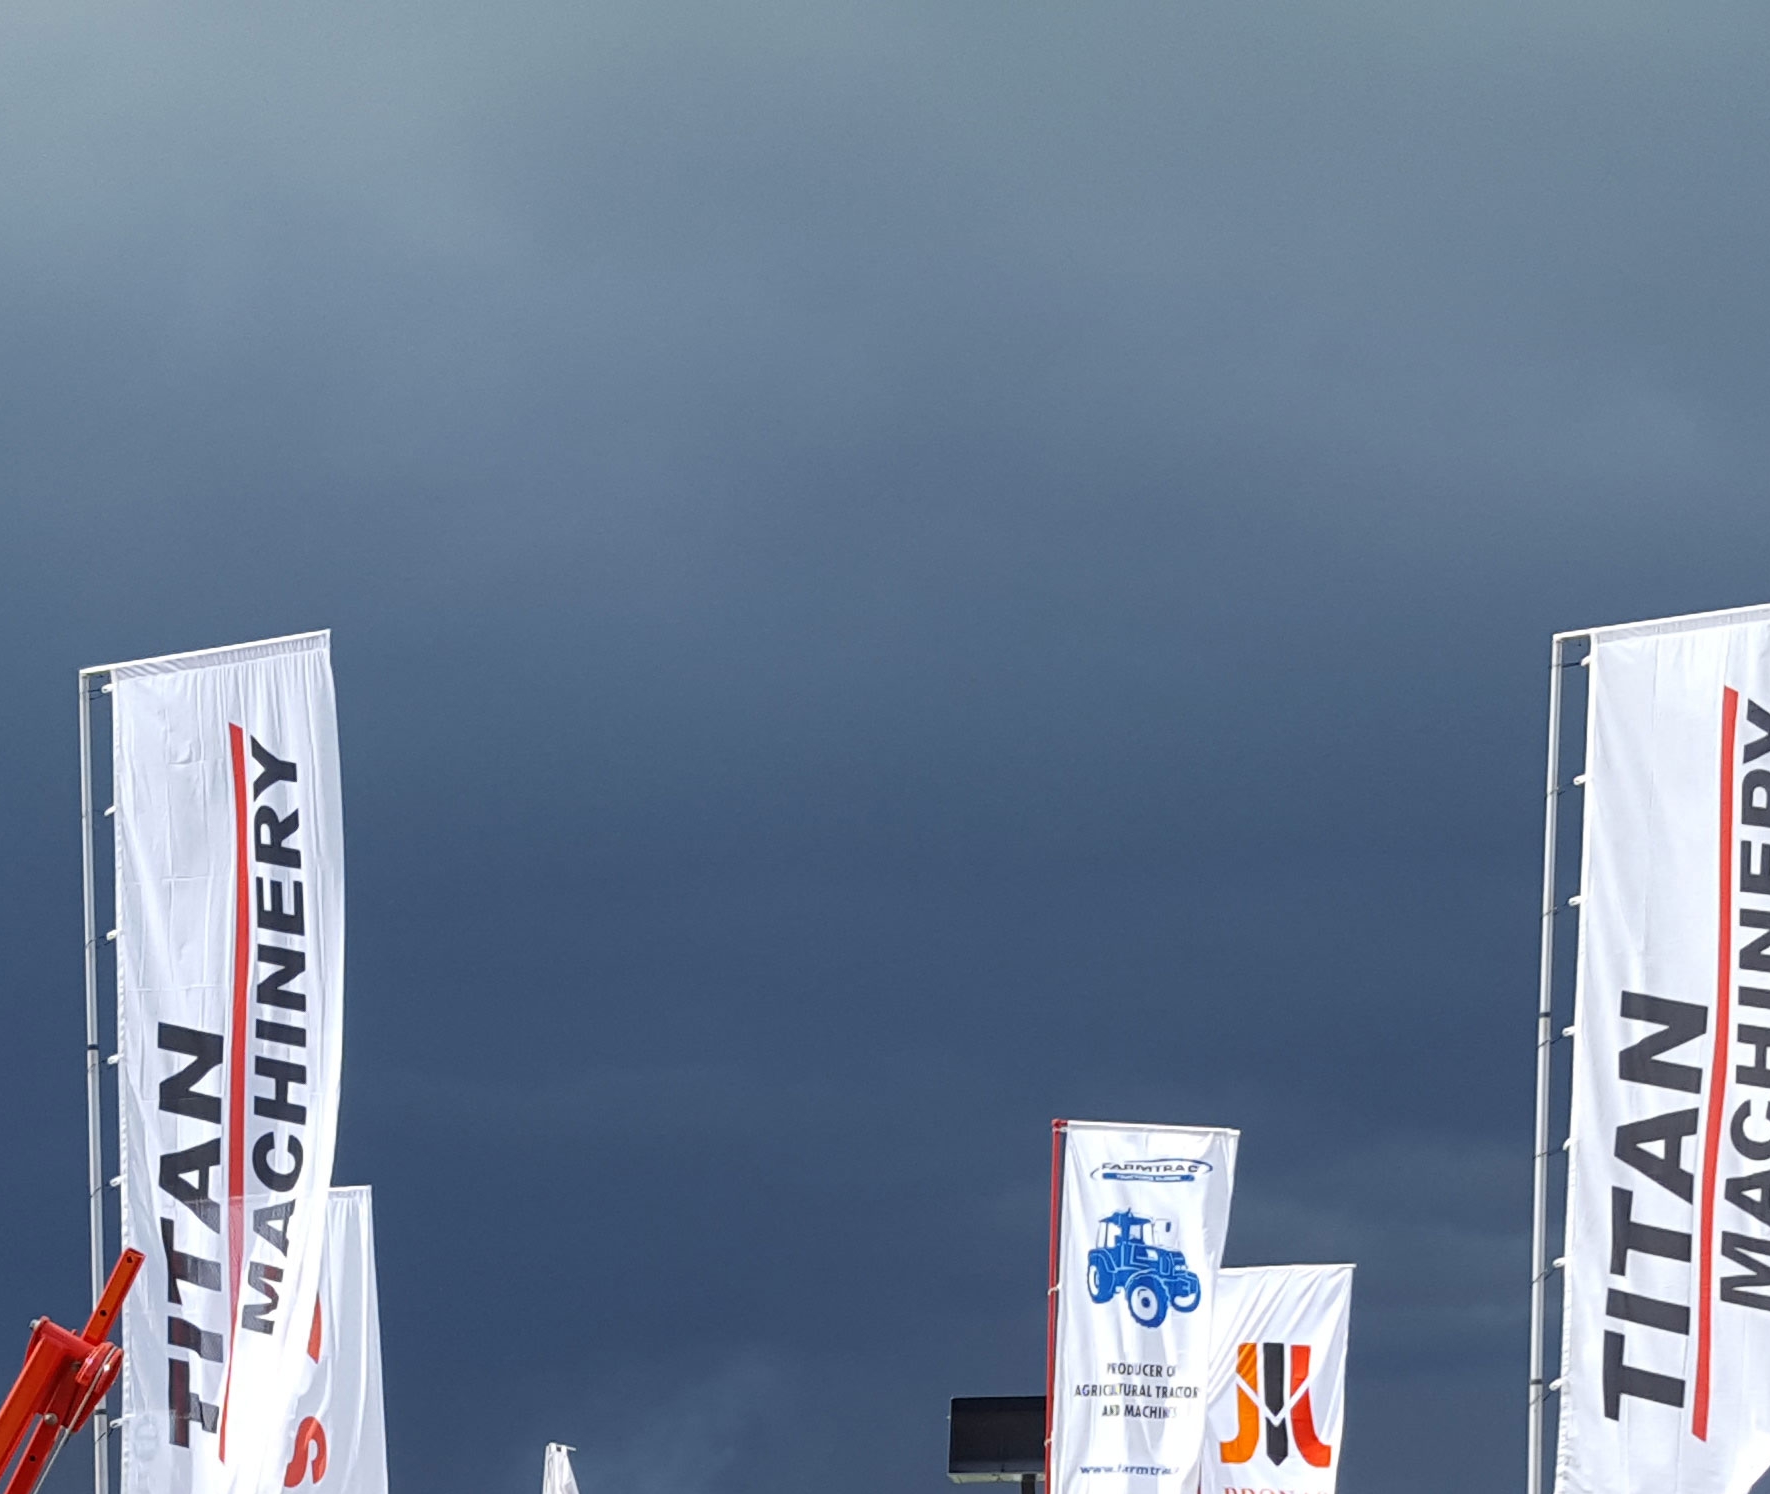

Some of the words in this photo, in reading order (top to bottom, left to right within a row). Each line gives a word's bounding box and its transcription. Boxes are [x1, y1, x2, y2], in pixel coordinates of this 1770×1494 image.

[158, 1022, 224, 1449] TITAN
[241, 734, 309, 1337] MACHINERY
[1102, 1162, 1199, 1173] FARMTRAC
[1601, 990, 1708, 1421] TITAN
